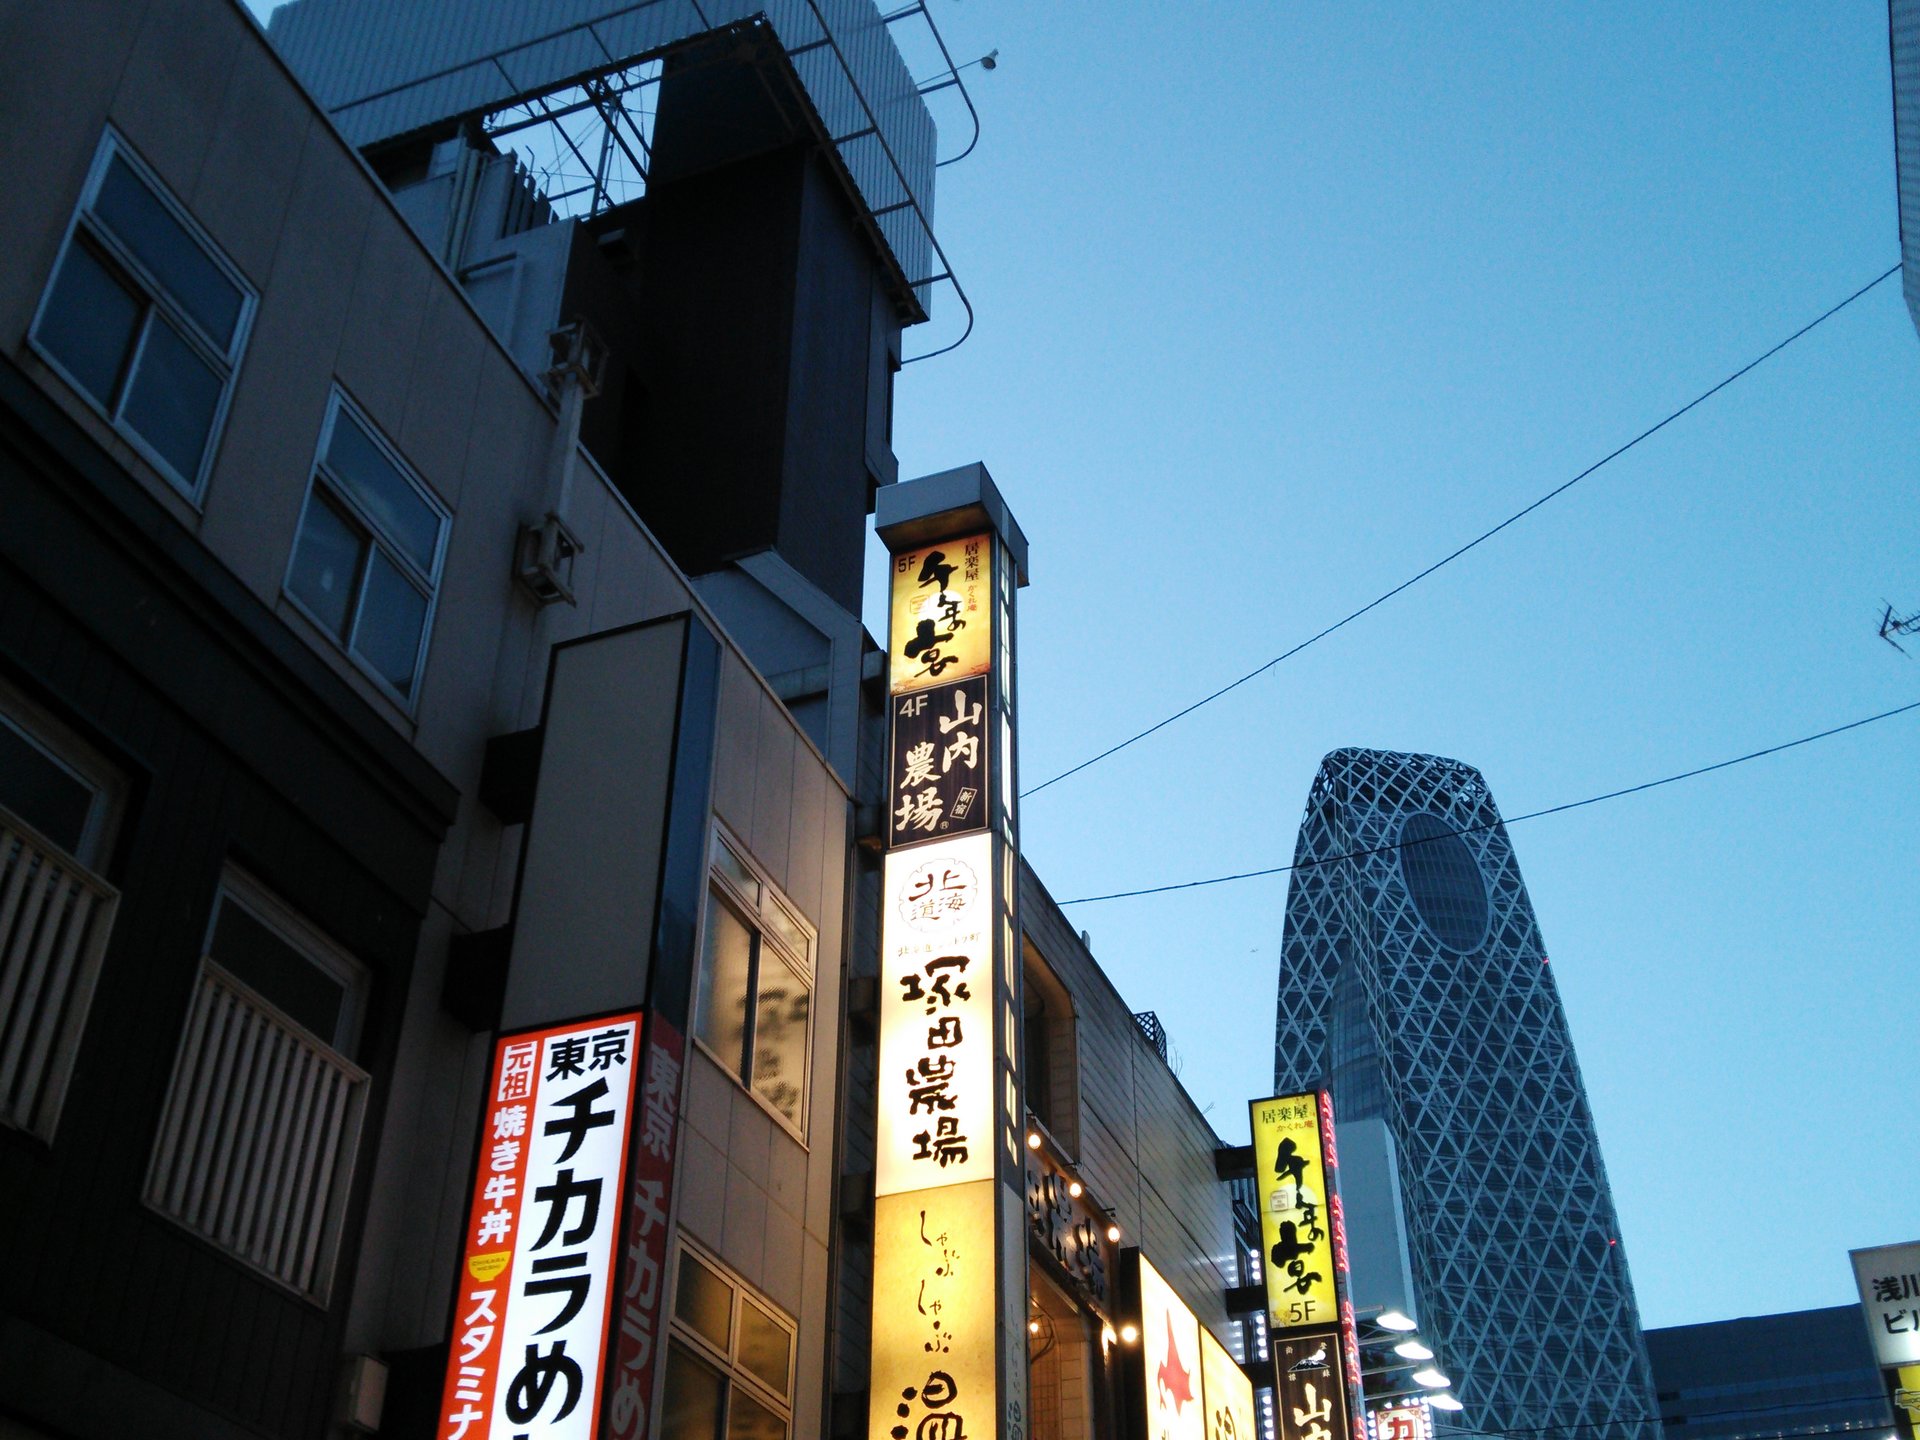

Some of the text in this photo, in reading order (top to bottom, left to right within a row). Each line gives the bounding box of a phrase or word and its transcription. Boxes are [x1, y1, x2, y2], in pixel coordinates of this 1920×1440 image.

[898, 555, 916, 573] 5F
[900, 695, 929, 718] 4F
[895, 690, 982, 831] 山内 農場
[502, 1044, 533, 1099] 元祖
[546, 1029, 630, 1082] 東京
[900, 955, 972, 1168] 塚田農場
[478, 1105, 525, 1245] 焼き牛丼
[505, 1077, 615, 1440] チカラめ
[1290, 1301, 1316, 1323] 5F
[448, 1289, 497, 1440] スタミナ
